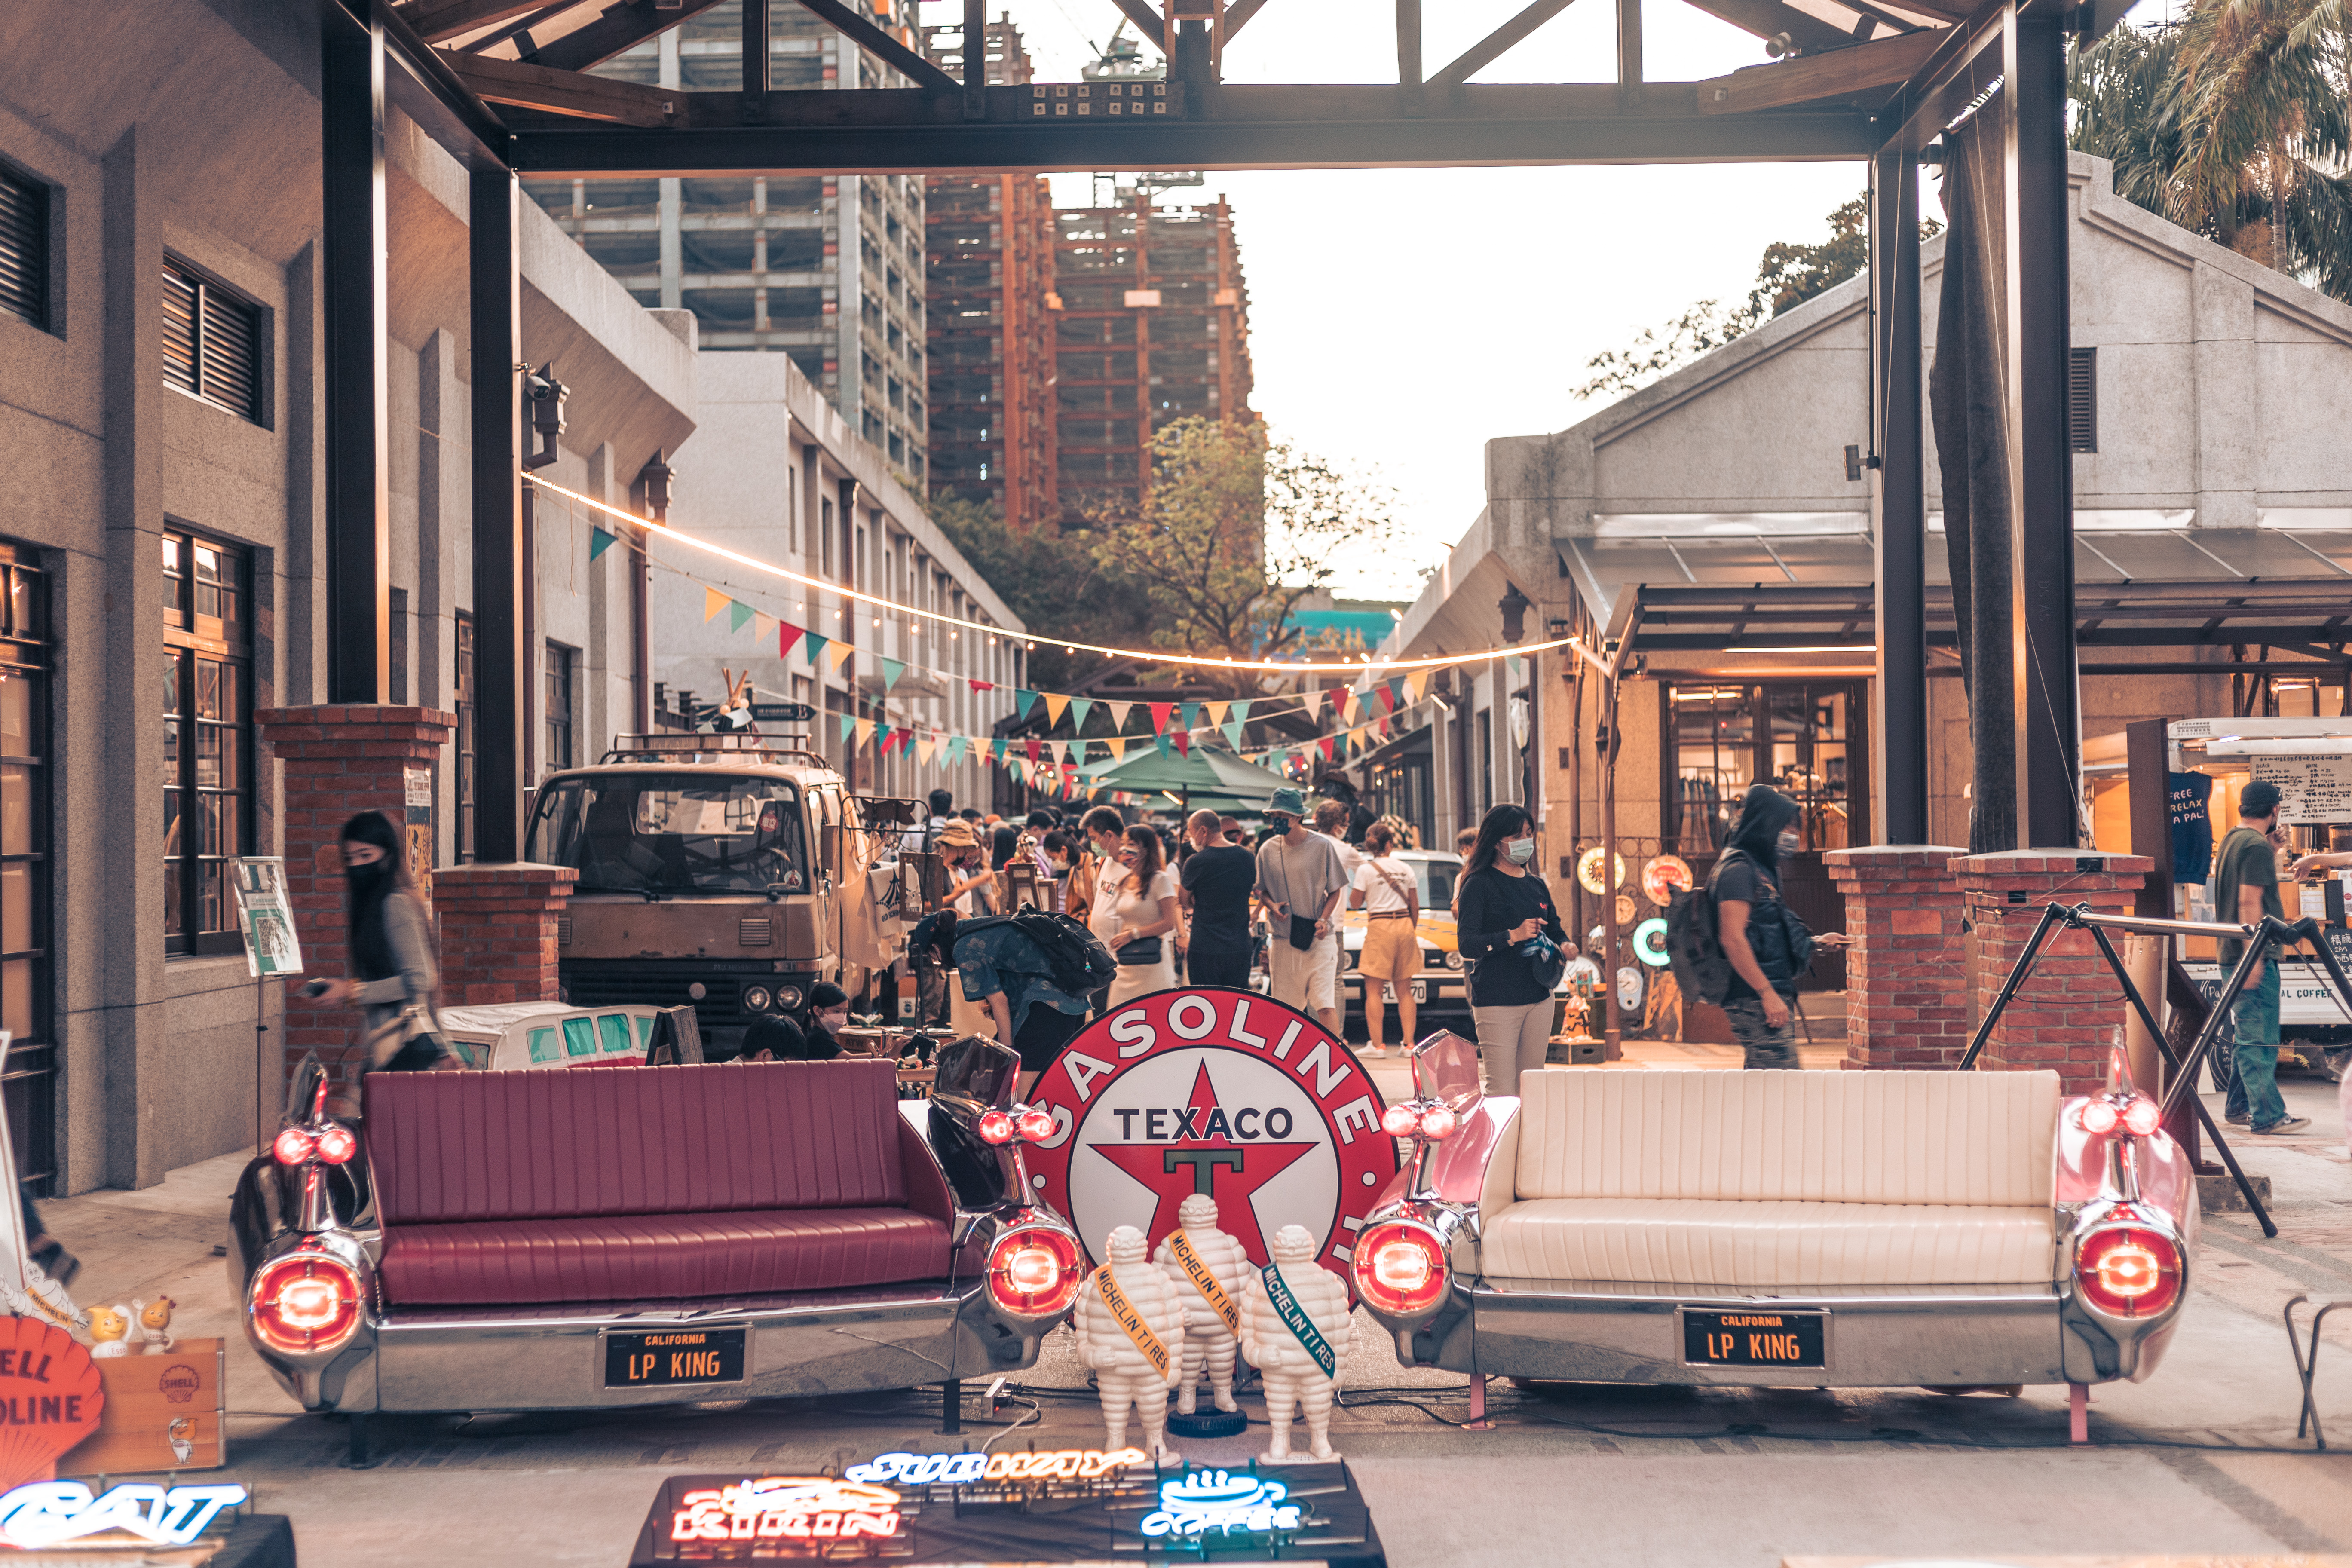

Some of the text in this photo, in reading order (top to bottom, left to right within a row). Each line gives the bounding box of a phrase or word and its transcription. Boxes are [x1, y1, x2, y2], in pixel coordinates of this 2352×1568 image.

[2170, 799, 2202, 813] RELAX
[1114, 1107, 1292, 1140] TEXACO
[1173, 1235, 1221, 1294] MICHELIN
[31, 1293, 68, 1323] MICHELIN
[1098, 1270, 1140, 1331] MICHELIN
[1265, 1268, 1306, 1332] MICHELIN
[1721, 1316, 1782, 1327] CALIFORNIA
[645, 1334, 706, 1346] CALIFORNIA
[1707, 1333, 1800, 1360] LP KING
[629, 1351, 720, 1380] LP KING
[165, 1378, 193, 1388] SHELL
